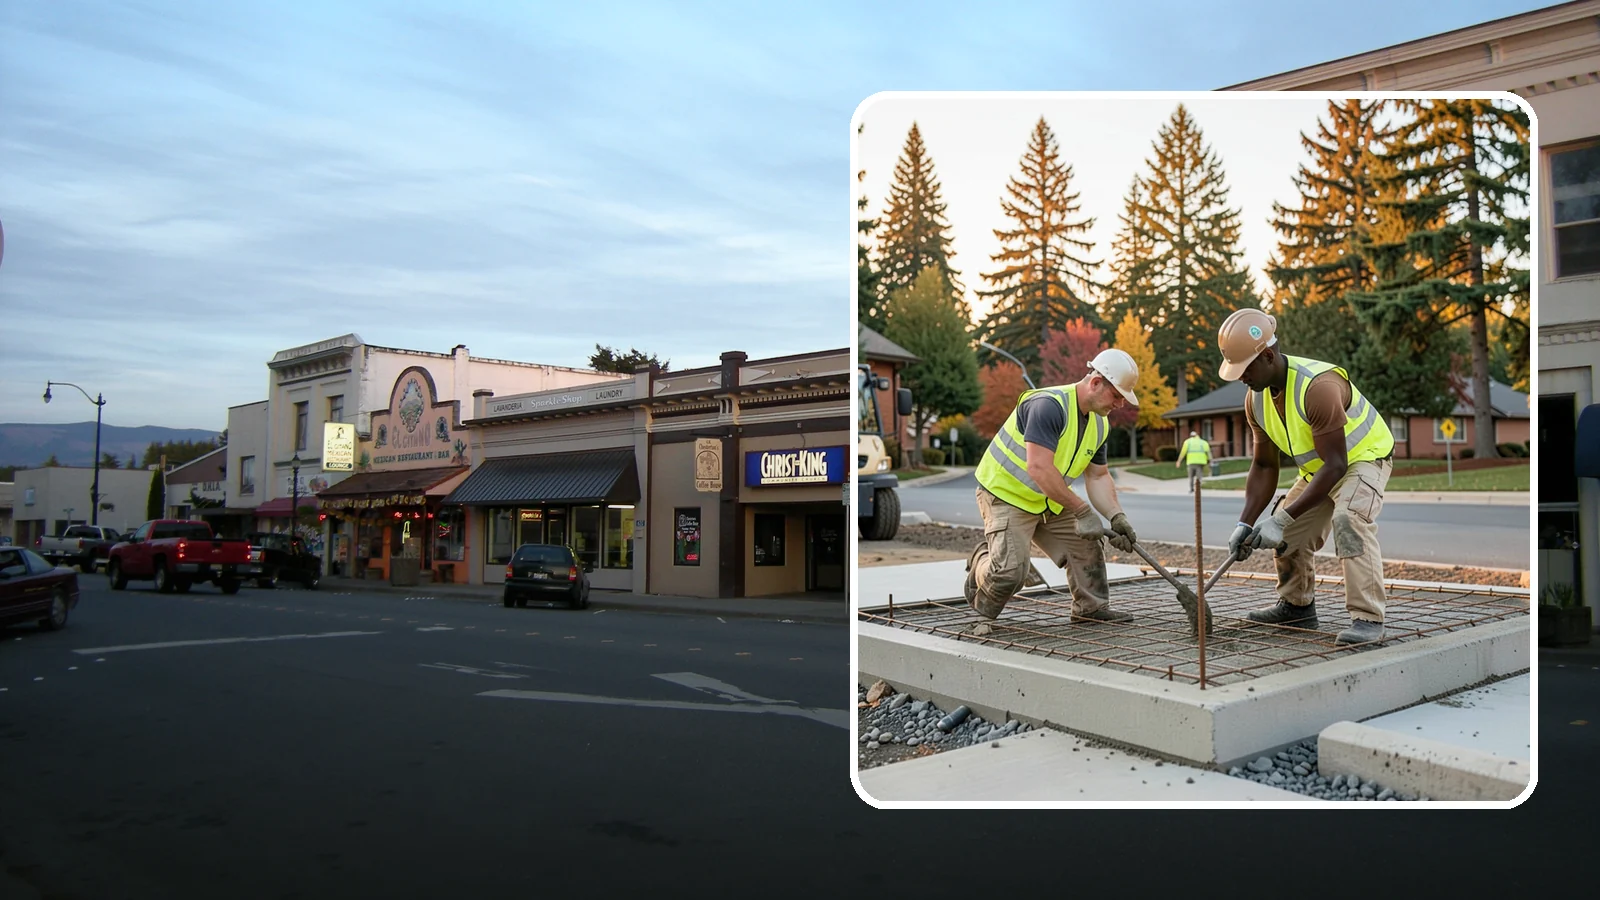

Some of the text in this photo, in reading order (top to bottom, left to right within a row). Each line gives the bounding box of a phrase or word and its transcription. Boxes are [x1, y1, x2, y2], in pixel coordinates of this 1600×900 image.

[493, 402, 522, 413] LAVANDERIA
[562, 394, 582, 405] Shop
[595, 389, 624, 400] LAUNDRY
[373, 450, 450, 464] MEXICAN RESTAURANT BAR
[761, 450, 827, 478] CHRIST KING
[697, 480, 721, 488] Coffee House
